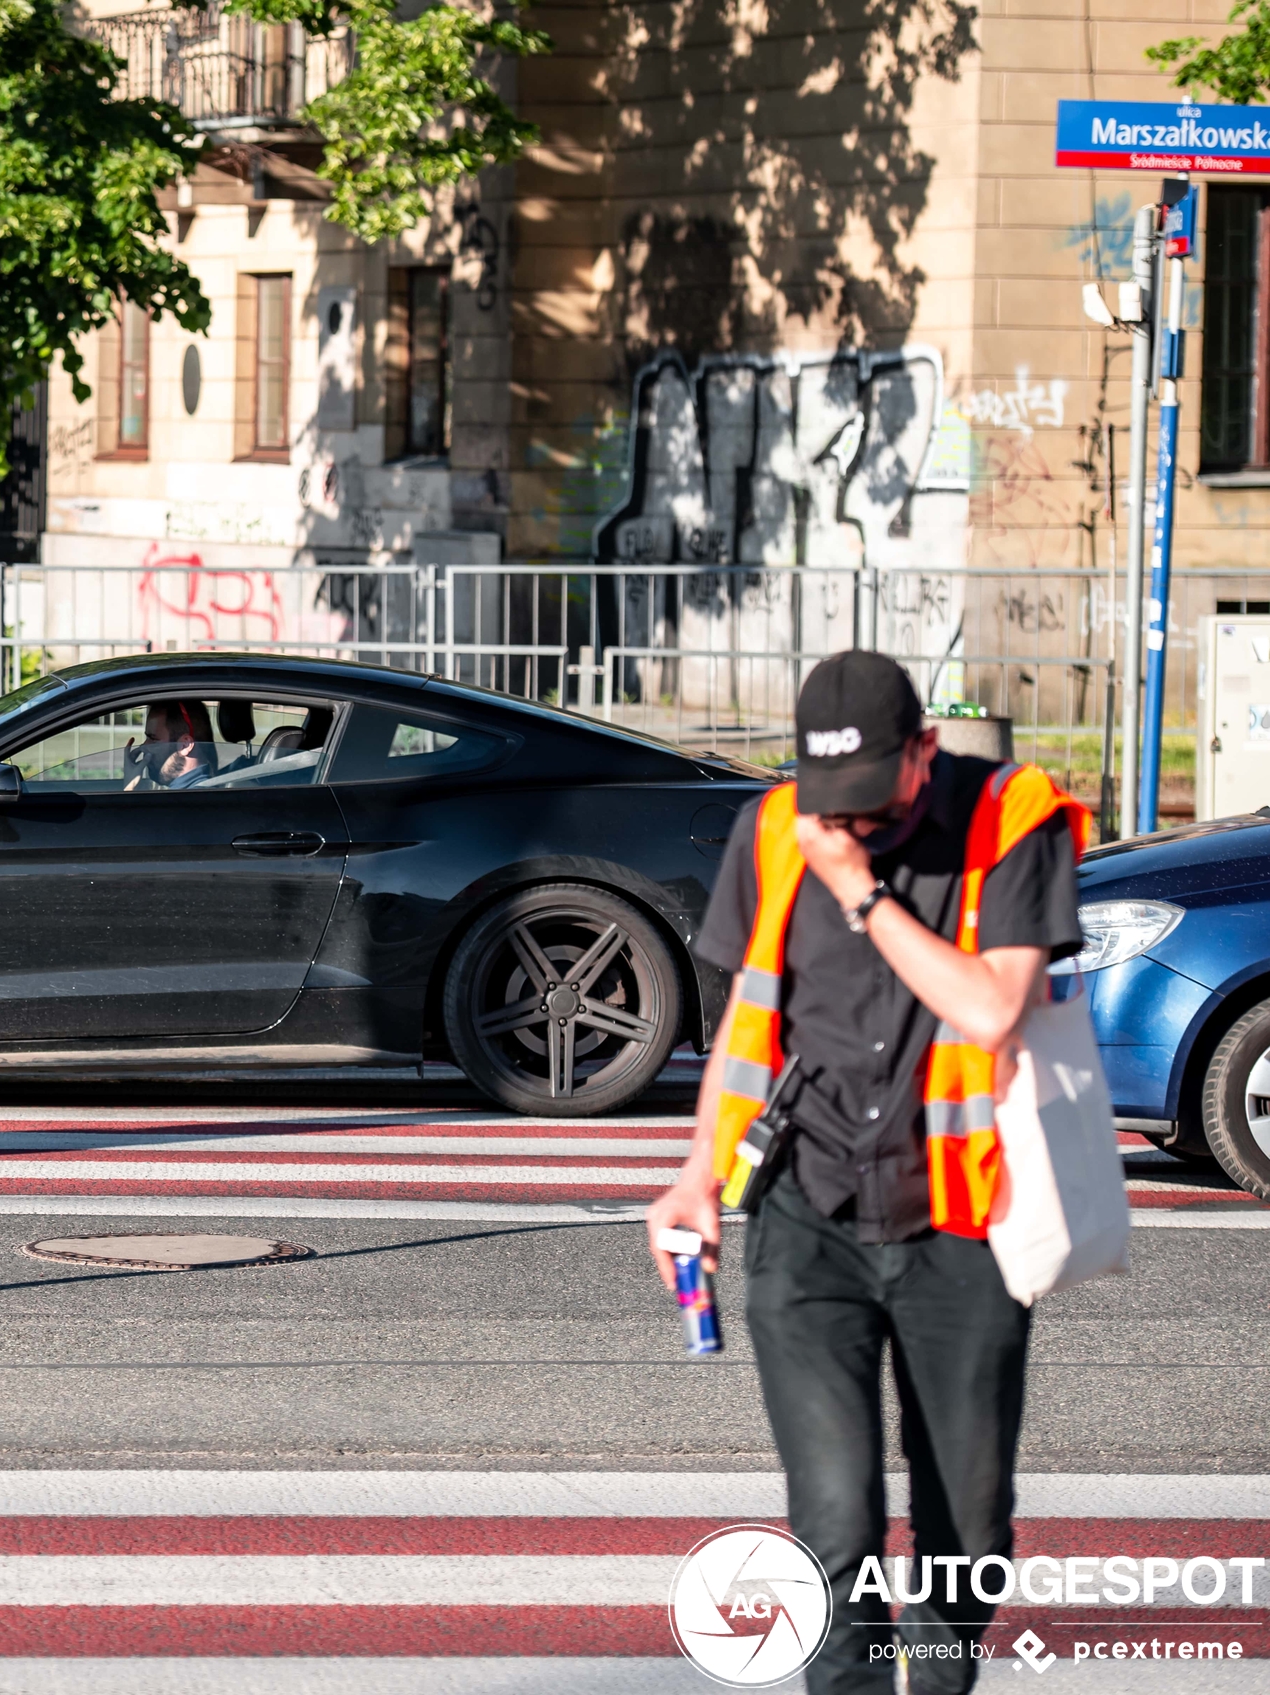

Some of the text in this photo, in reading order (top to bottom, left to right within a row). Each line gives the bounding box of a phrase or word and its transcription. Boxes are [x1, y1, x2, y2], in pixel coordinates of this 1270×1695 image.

[1176, 106, 1202, 118] ulica
[1130, 152, 1243, 171] Śródmieście Północne
